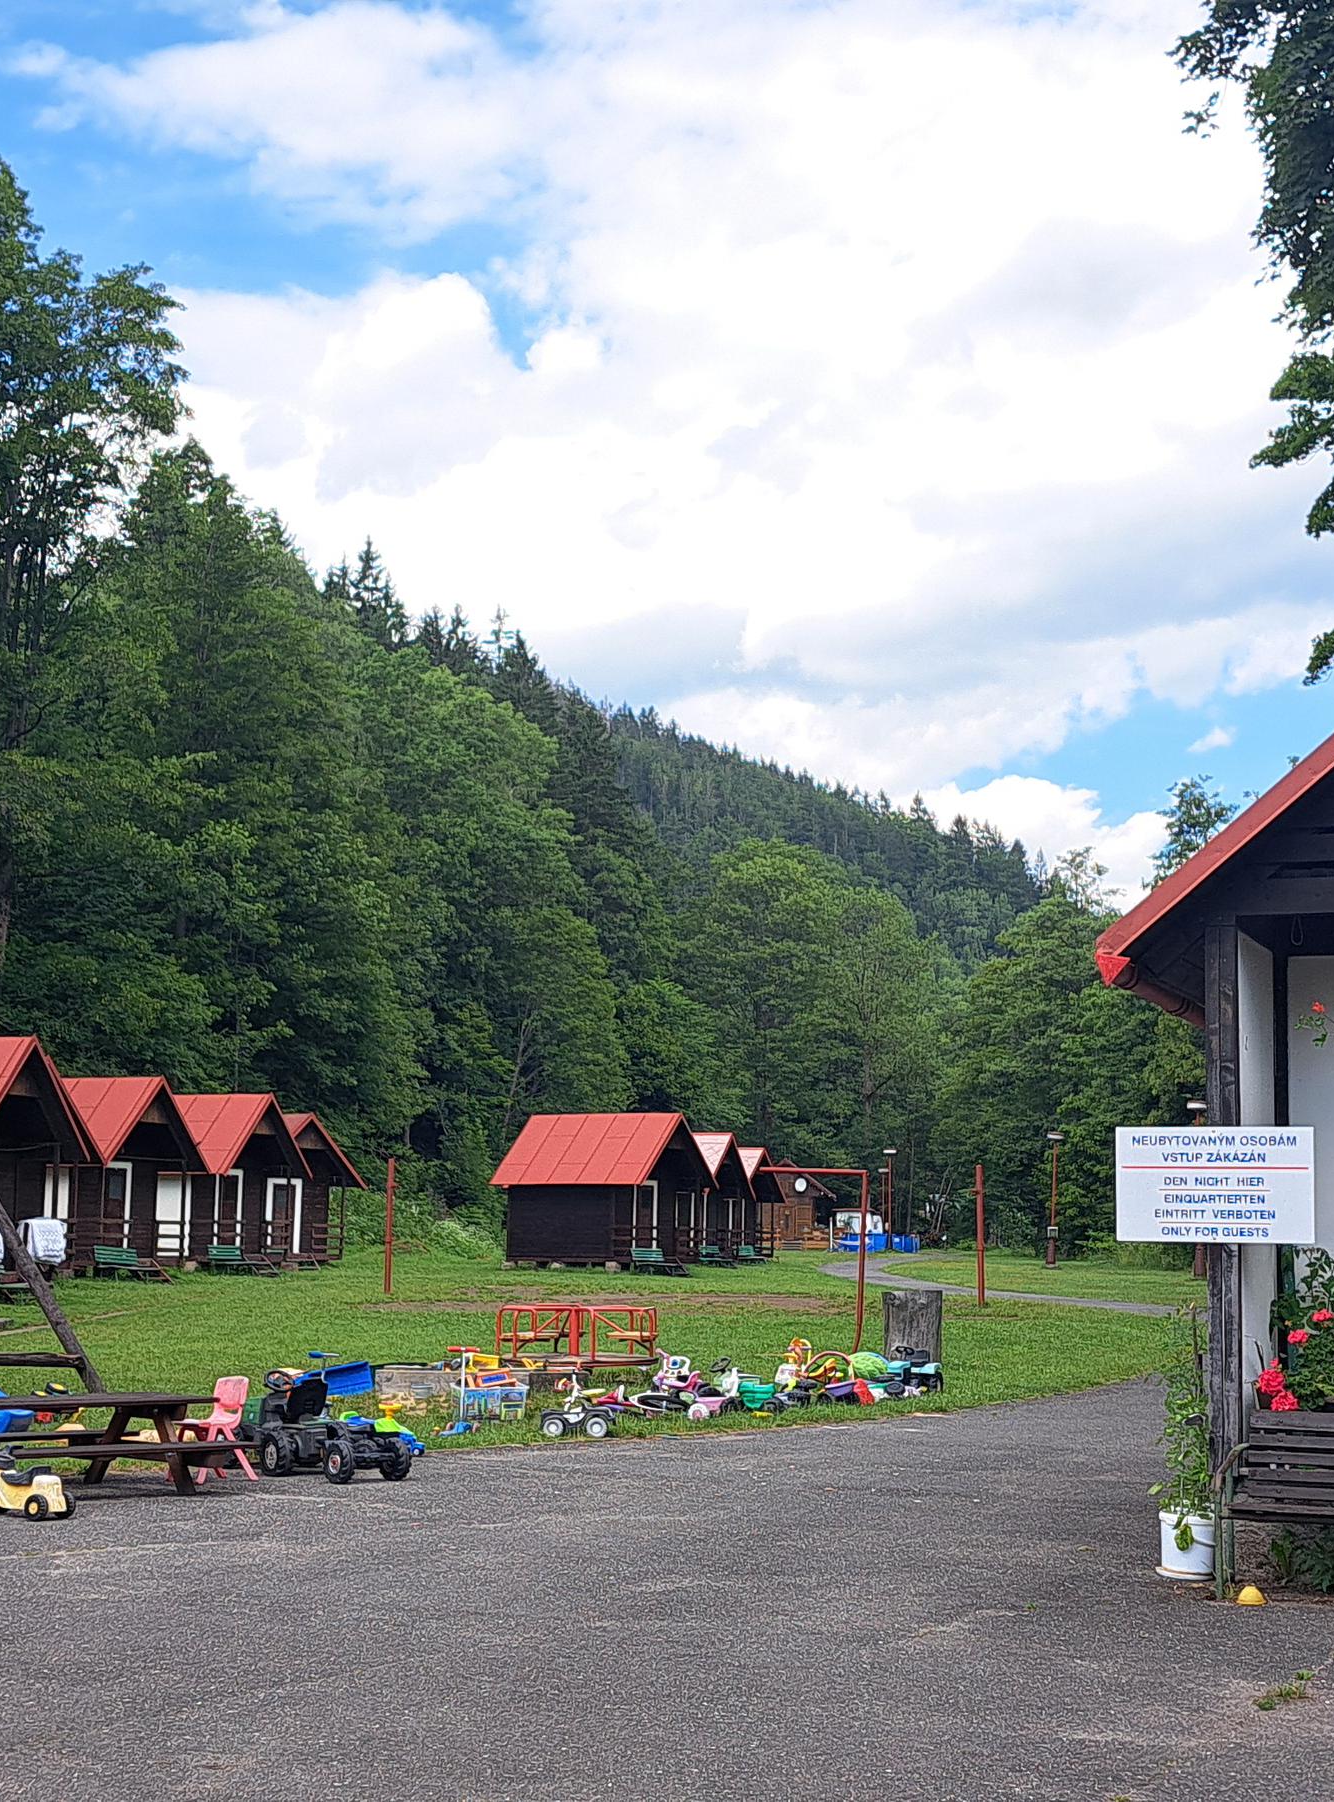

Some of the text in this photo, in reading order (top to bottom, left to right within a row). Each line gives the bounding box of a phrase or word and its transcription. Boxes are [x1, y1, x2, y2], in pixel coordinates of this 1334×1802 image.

[1132, 1133, 1297, 1146] NEUBYTOVANÝM OSOBÁM
[1162, 1152, 1203, 1163] VSTUP
[1164, 1177, 1265, 1186] DEN NICHT HIER
[1164, 1194, 1265, 1204] EINQUARTIERTEN
[1154, 1209, 1276, 1220] EINTRITT VERBOTEN
[1161, 1227, 1269, 1237] ONLY FOR GUESTS
